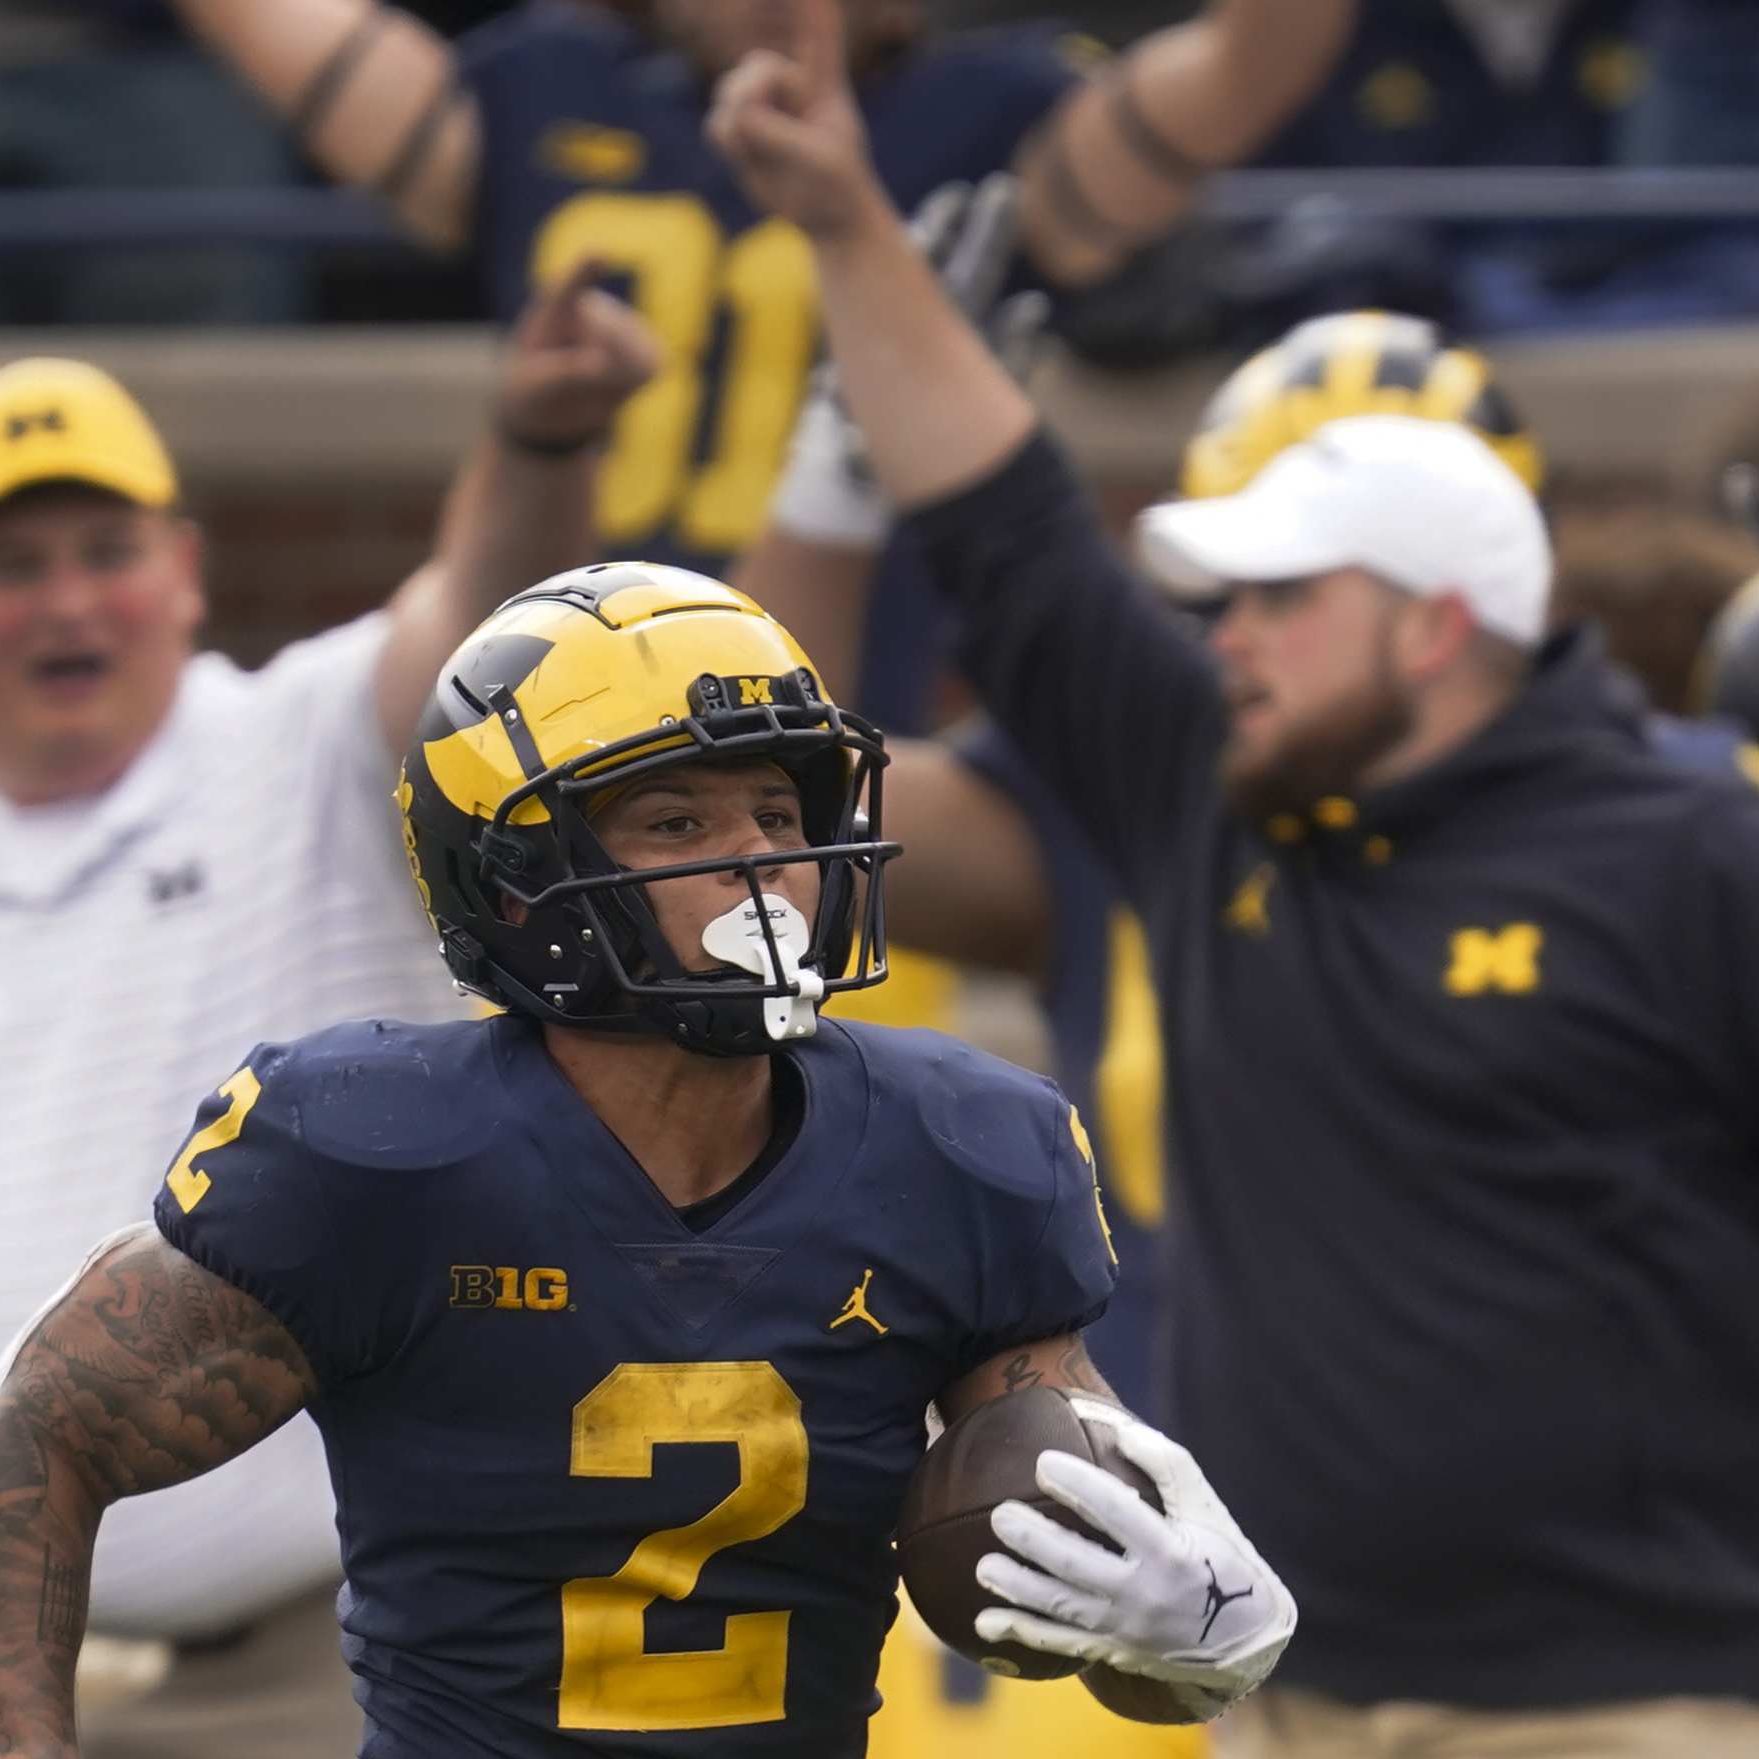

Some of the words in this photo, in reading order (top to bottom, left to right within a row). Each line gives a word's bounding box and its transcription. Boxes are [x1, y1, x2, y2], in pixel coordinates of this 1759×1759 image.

[738, 678, 773, 705] M
[1445, 920, 1544, 997] M
[166, 1065, 262, 1214] 2
[557, 1361, 809, 1732] 2
